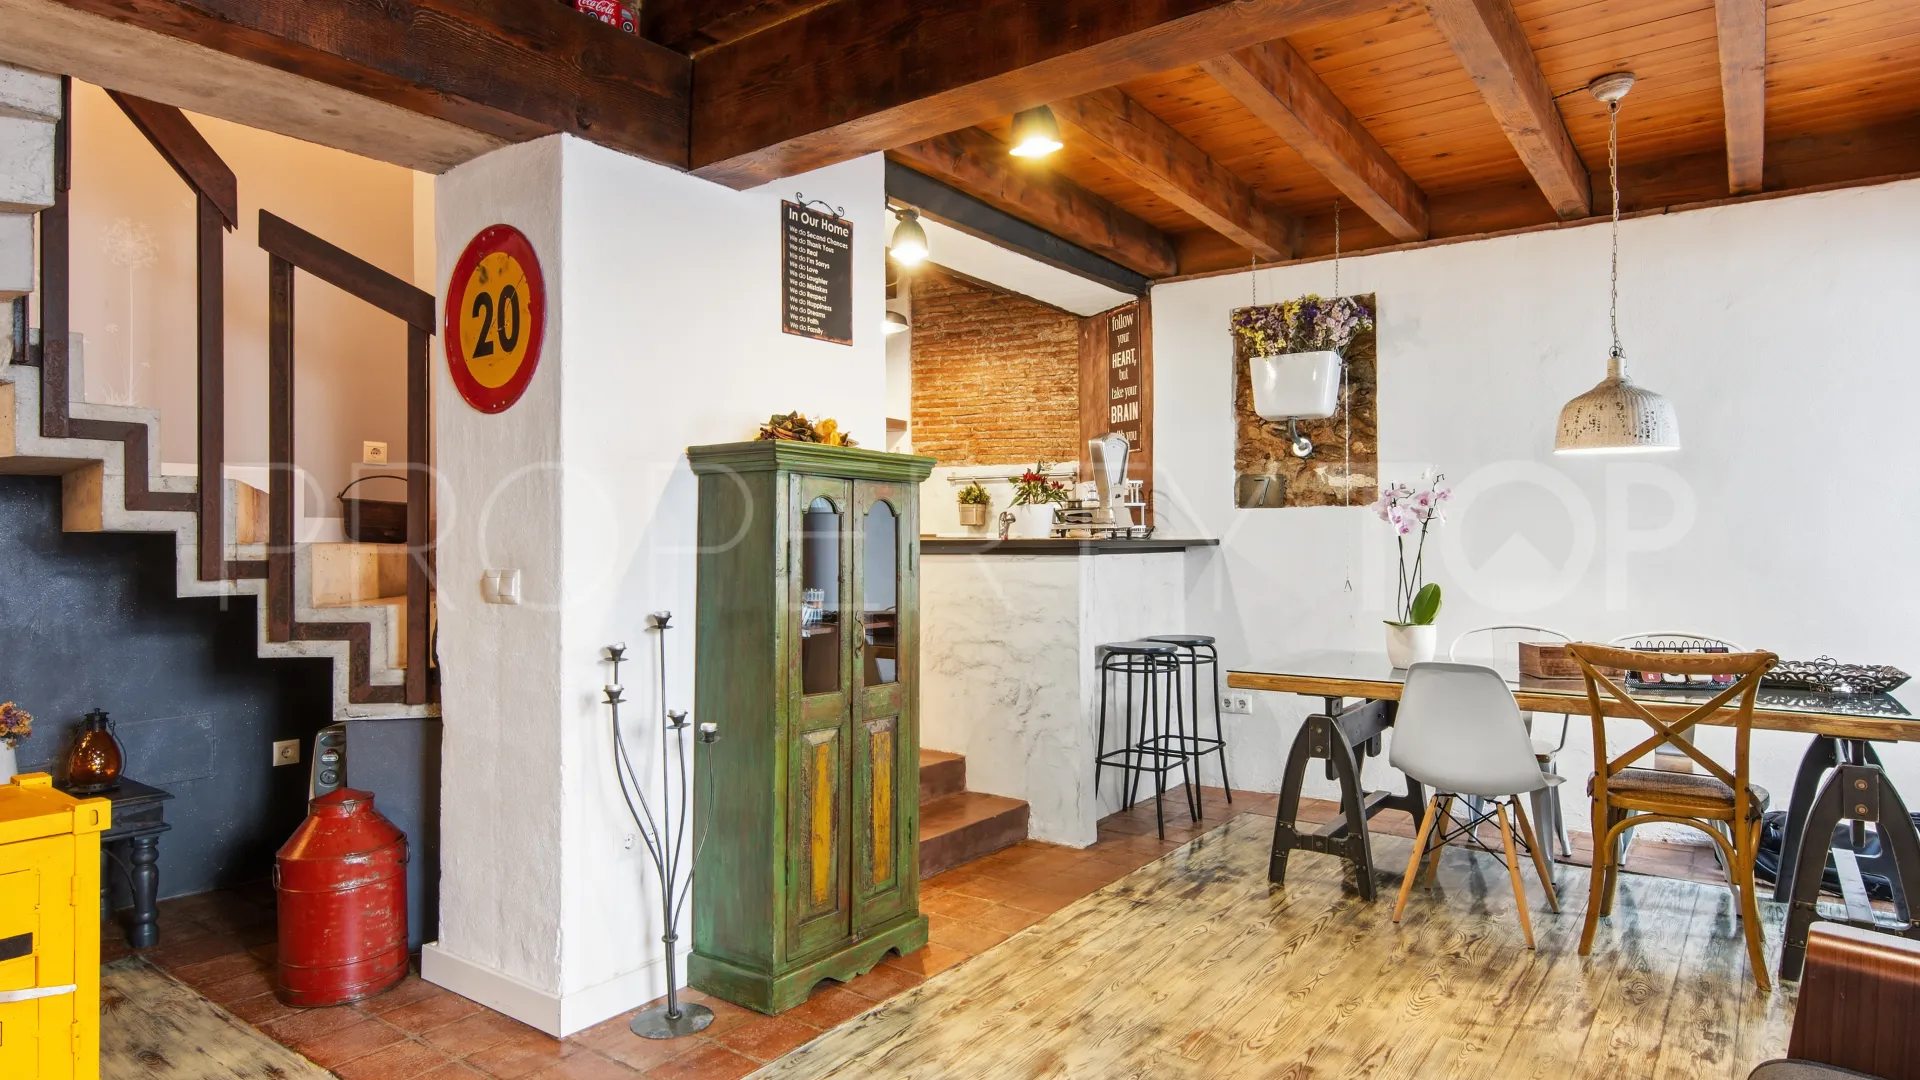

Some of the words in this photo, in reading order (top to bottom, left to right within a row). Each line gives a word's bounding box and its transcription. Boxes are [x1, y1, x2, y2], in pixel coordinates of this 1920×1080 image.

[789, 207, 798, 222] In
[801, 214, 818, 228] Our
[822, 220, 849, 237] Home
[789, 234, 798, 242] We
[799, 237, 806, 245] do
[807, 240, 822, 250] Thank
[823, 244, 834, 253] Yous
[799, 228, 806, 236] do
[807, 230, 826, 243] Second
[827, 237, 848, 249] Chances
[789, 243, 798, 251] We
[799, 246, 806, 254] do
[807, 266, 818, 274] Love
[816, 259, 830, 269] Sorrys
[789, 278, 798, 286] We
[799, 281, 806, 289] do
[807, 283, 828, 294] Mistakes
[807, 274, 828, 286] Laughter
[789, 287, 798, 295] We
[799, 290, 806, 298] do
[807, 292, 826, 302] Respect
[789, 296, 798, 304] We
[799, 298, 806, 307] do
[807, 301, 832, 312] Happiness
[789, 304, 798, 312] We
[799, 307, 806, 315] do
[807, 309, 825, 319] Dreams
[472, 284, 520, 358] 20
[789, 313, 798, 321] We
[799, 316, 806, 324] do
[1112, 313, 1134, 331] follow
[789, 322, 798, 330] We
[799, 324, 806, 332] do
[807, 326, 823, 336] Family
[1117, 332, 1130, 347] your
[1112, 348, 1136, 369] HEART,
[1118, 368, 1128, 381] but
[1112, 386, 1124, 400] take
[1124, 385, 1137, 400] your
[1111, 402, 1138, 424] BRAIN
